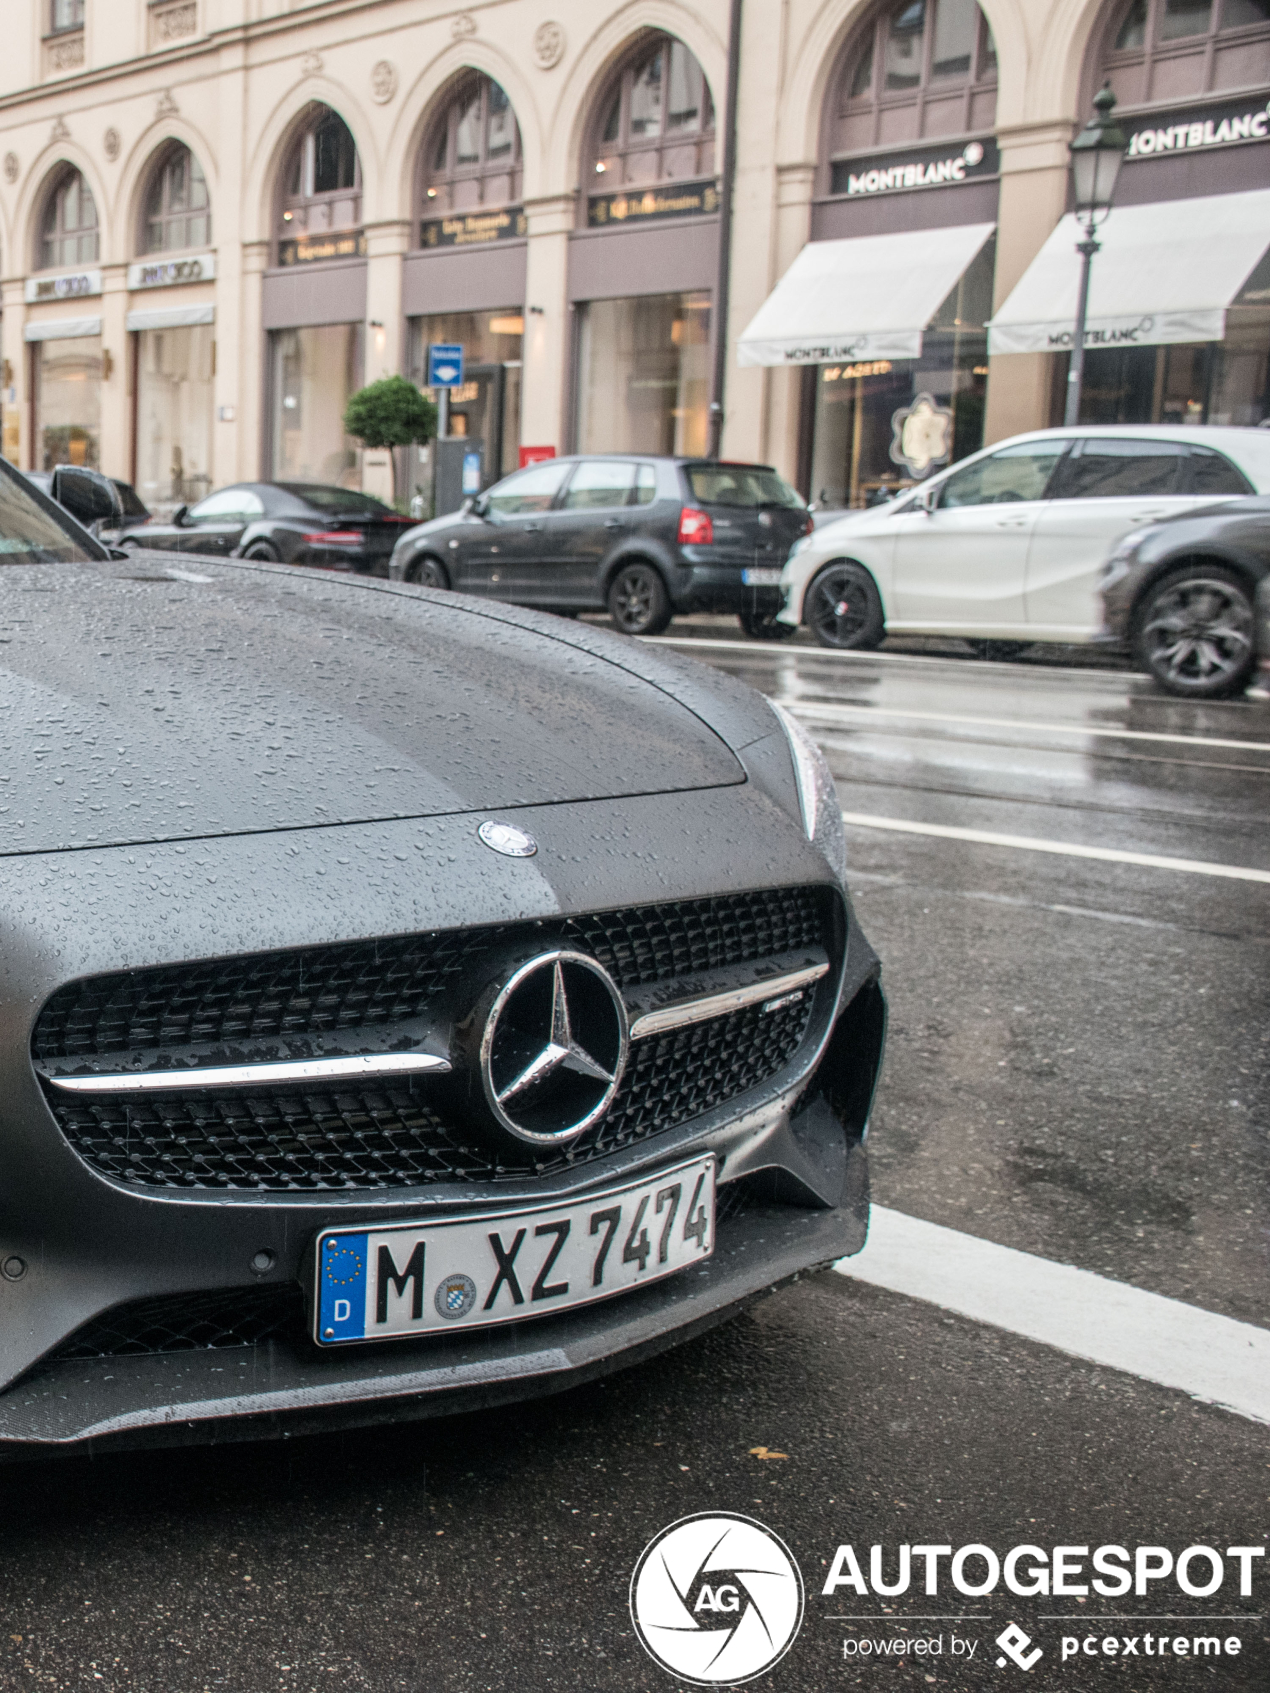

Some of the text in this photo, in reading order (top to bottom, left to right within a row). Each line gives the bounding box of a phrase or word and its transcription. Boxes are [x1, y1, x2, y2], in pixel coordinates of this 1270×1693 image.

[847, 156, 966, 195] MONTBLANC
[1047, 328, 1138, 345] MOTBLANC
[783, 345, 855, 360] MONTBLANC
[376, 1241, 426, 1324] M
[483, 1218, 571, 1311] XZ
[589, 1172, 708, 1288] 7474
[334, 1299, 351, 1322] D
